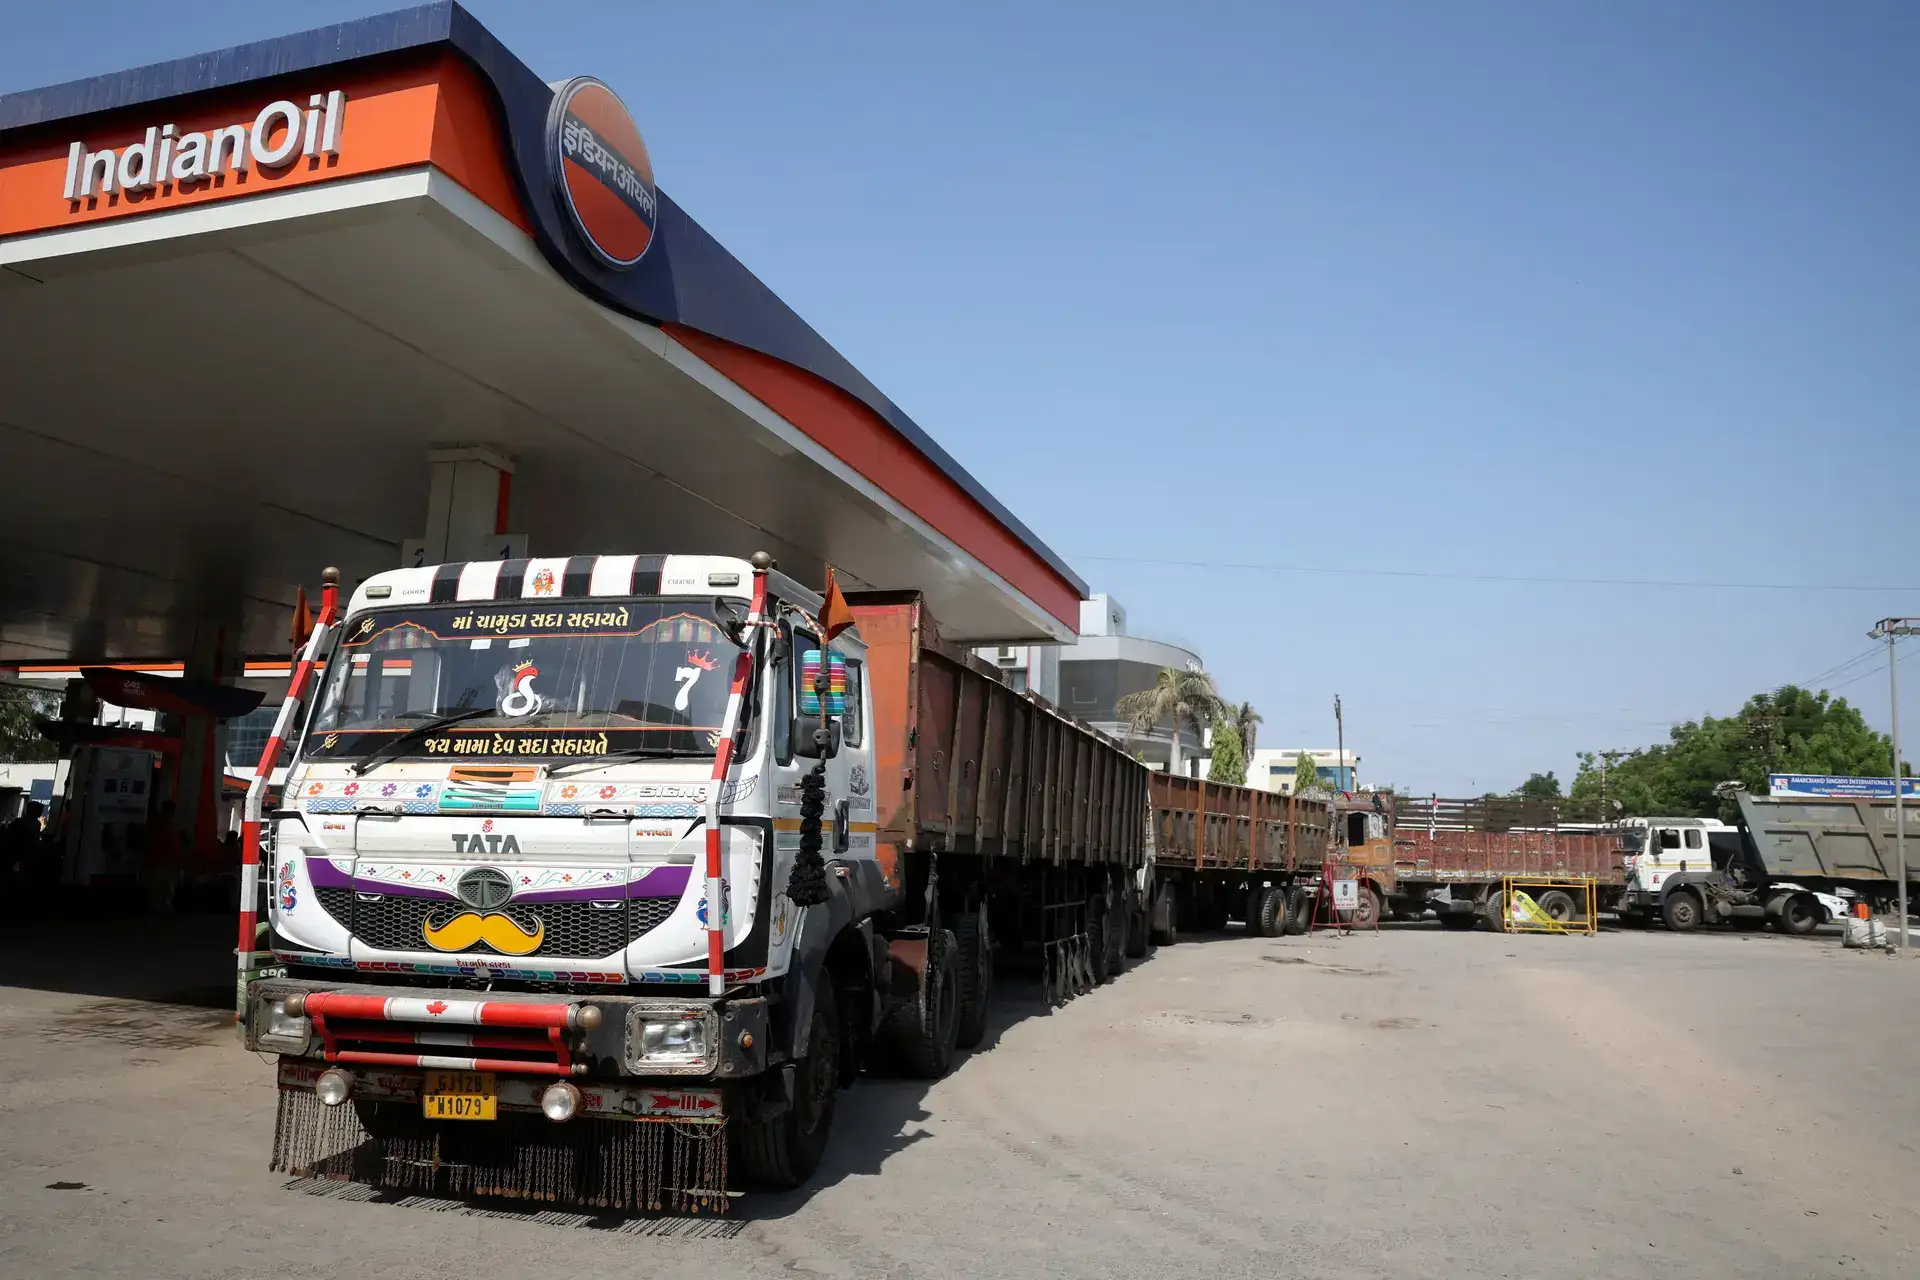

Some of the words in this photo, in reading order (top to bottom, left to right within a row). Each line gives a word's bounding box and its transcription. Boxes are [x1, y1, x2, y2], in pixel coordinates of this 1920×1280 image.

[62, 89, 346, 202] IndianOil
[563, 119, 655, 219] इंडियनऑयल
[530, 612, 564, 629] સદા
[566, 606, 630, 628] સહાયતે
[674, 666, 702, 711] 7
[424, 737, 450, 754] જય
[453, 738, 490, 754] મામા
[492, 733, 516, 755] દેવ
[518, 738, 548, 754] સદા
[550, 733, 609, 755] સહાયતે
[451, 833, 522, 854] TATA
